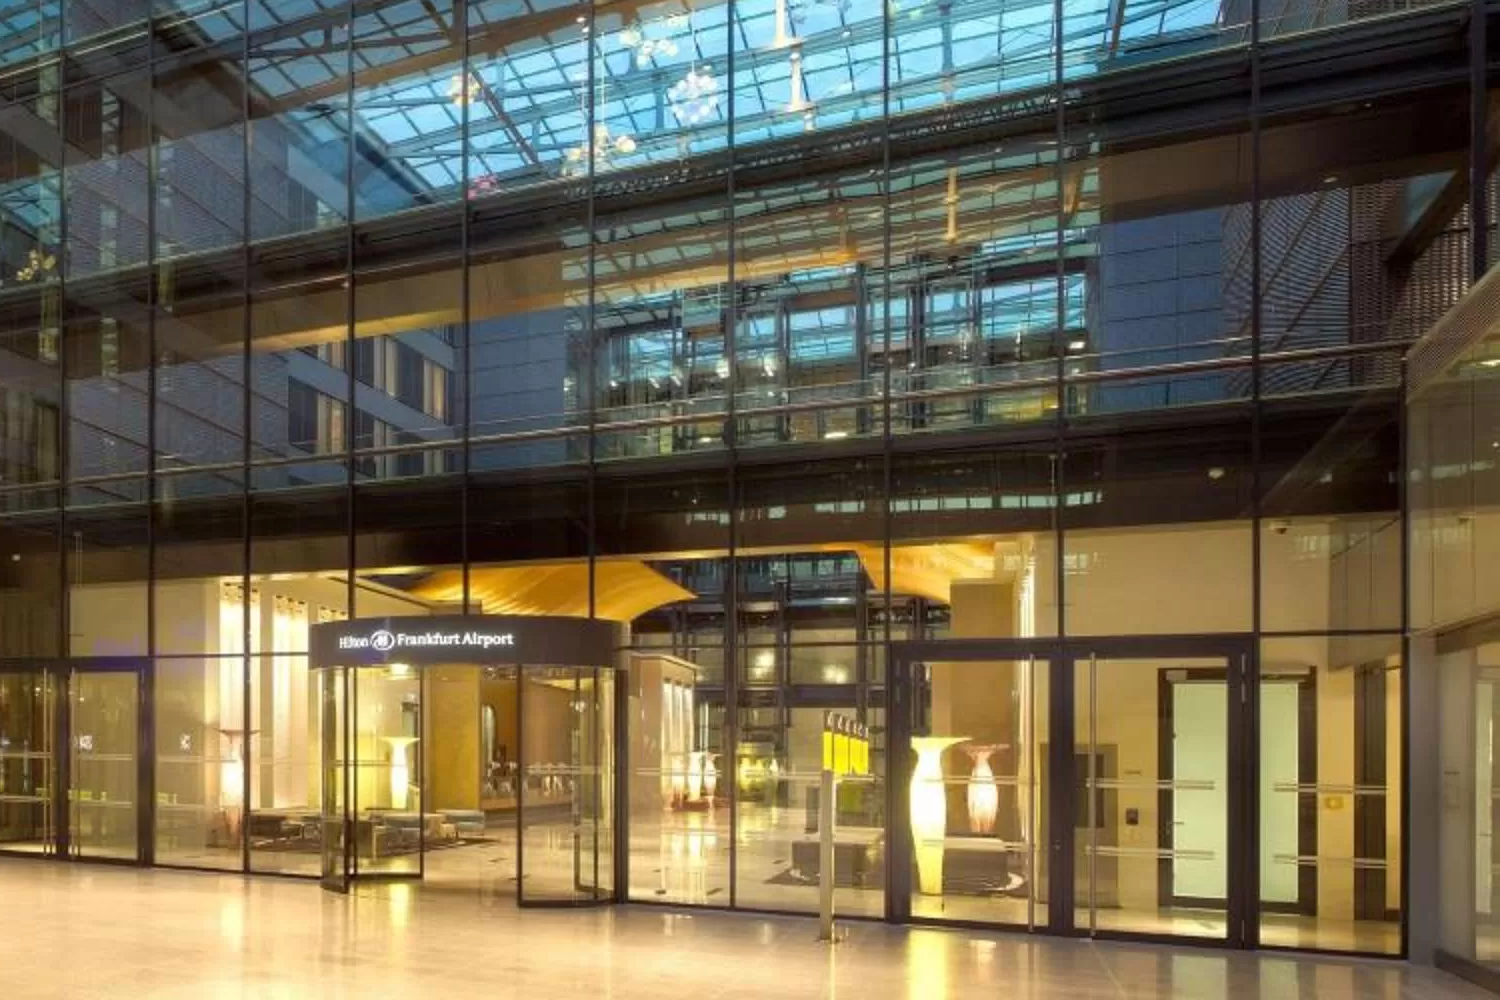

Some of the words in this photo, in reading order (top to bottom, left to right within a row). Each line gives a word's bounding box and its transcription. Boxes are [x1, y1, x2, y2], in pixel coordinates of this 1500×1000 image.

[339, 634, 369, 649] Hilton
[397, 632, 460, 646] Frankfurt
[462, 632, 514, 648] Airport
